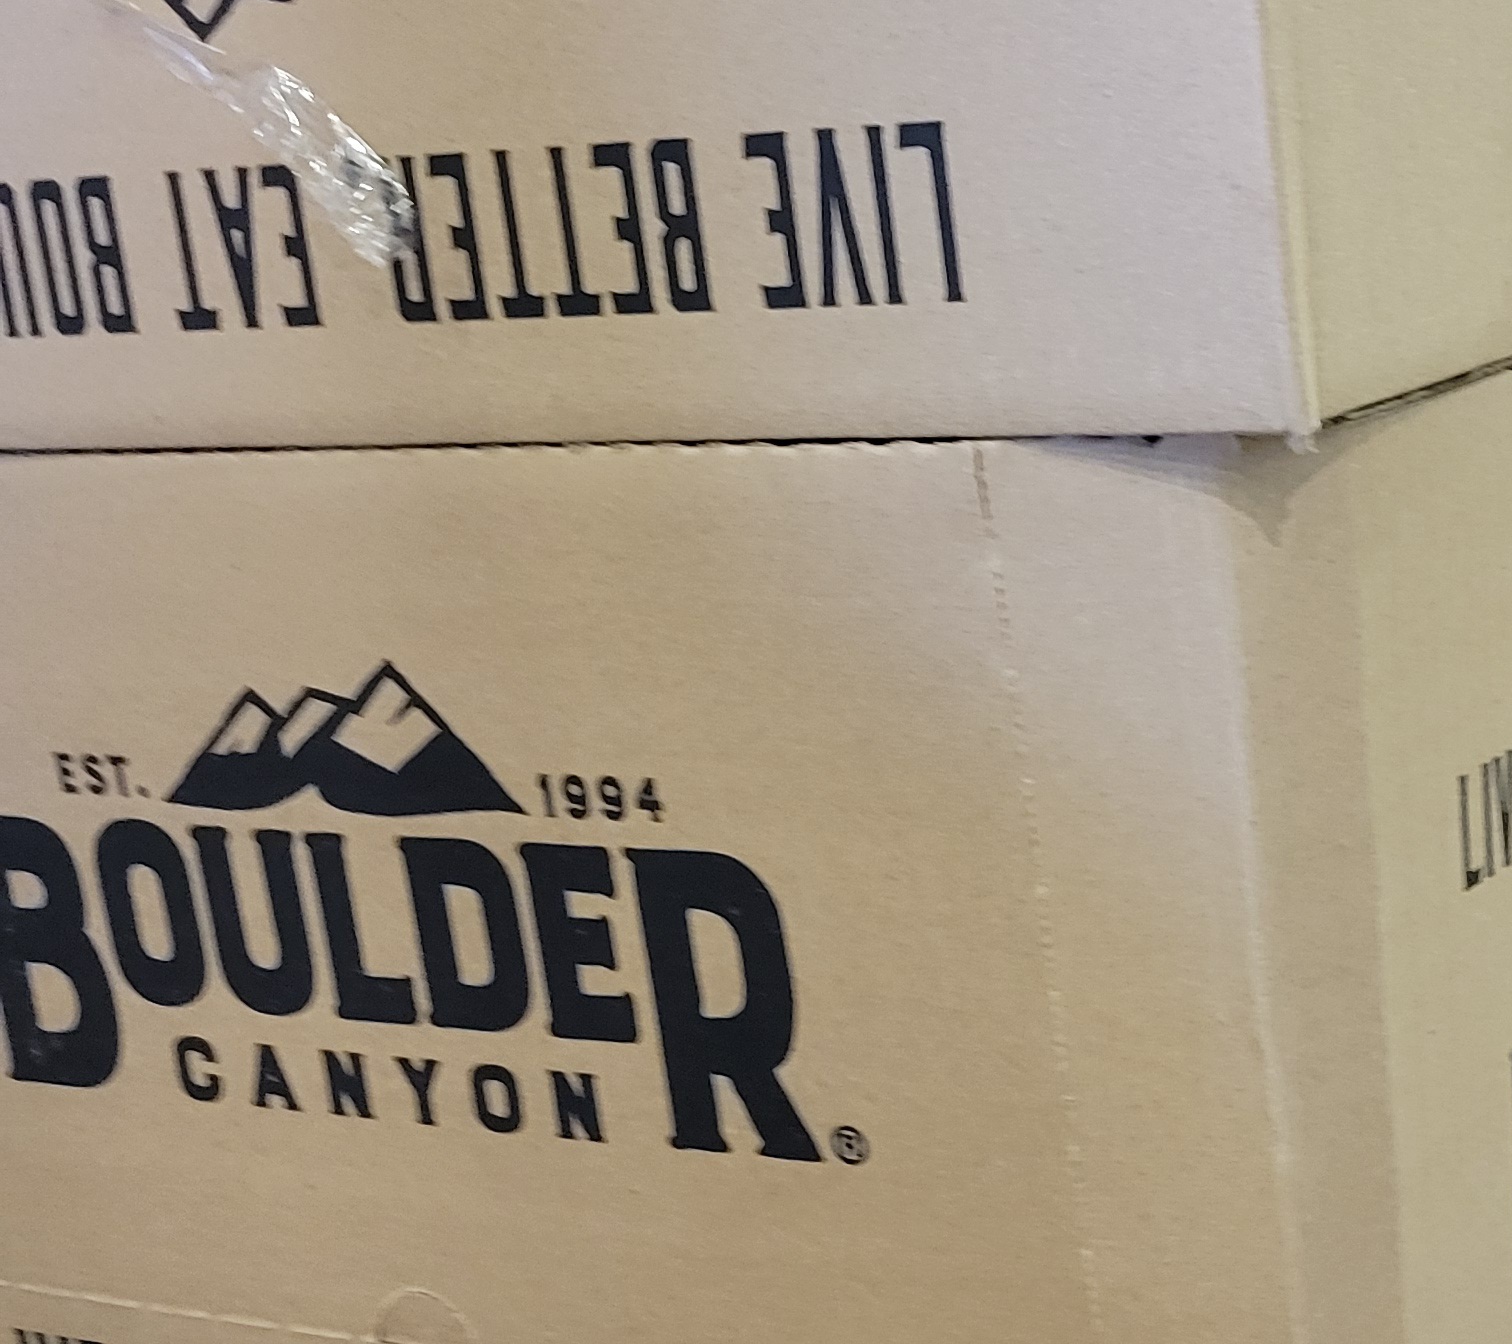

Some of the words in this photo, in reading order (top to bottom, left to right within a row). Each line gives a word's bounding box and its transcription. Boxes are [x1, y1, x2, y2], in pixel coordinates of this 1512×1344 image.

[166, 165, 324, 330] EAT
[744, 121, 967, 309] LIVE
[53, 750, 150, 798] EST.
[537, 773, 667, 823] 1994
[0, 815, 826, 1163] BOULDER
[175, 1037, 607, 1146] CANYON
